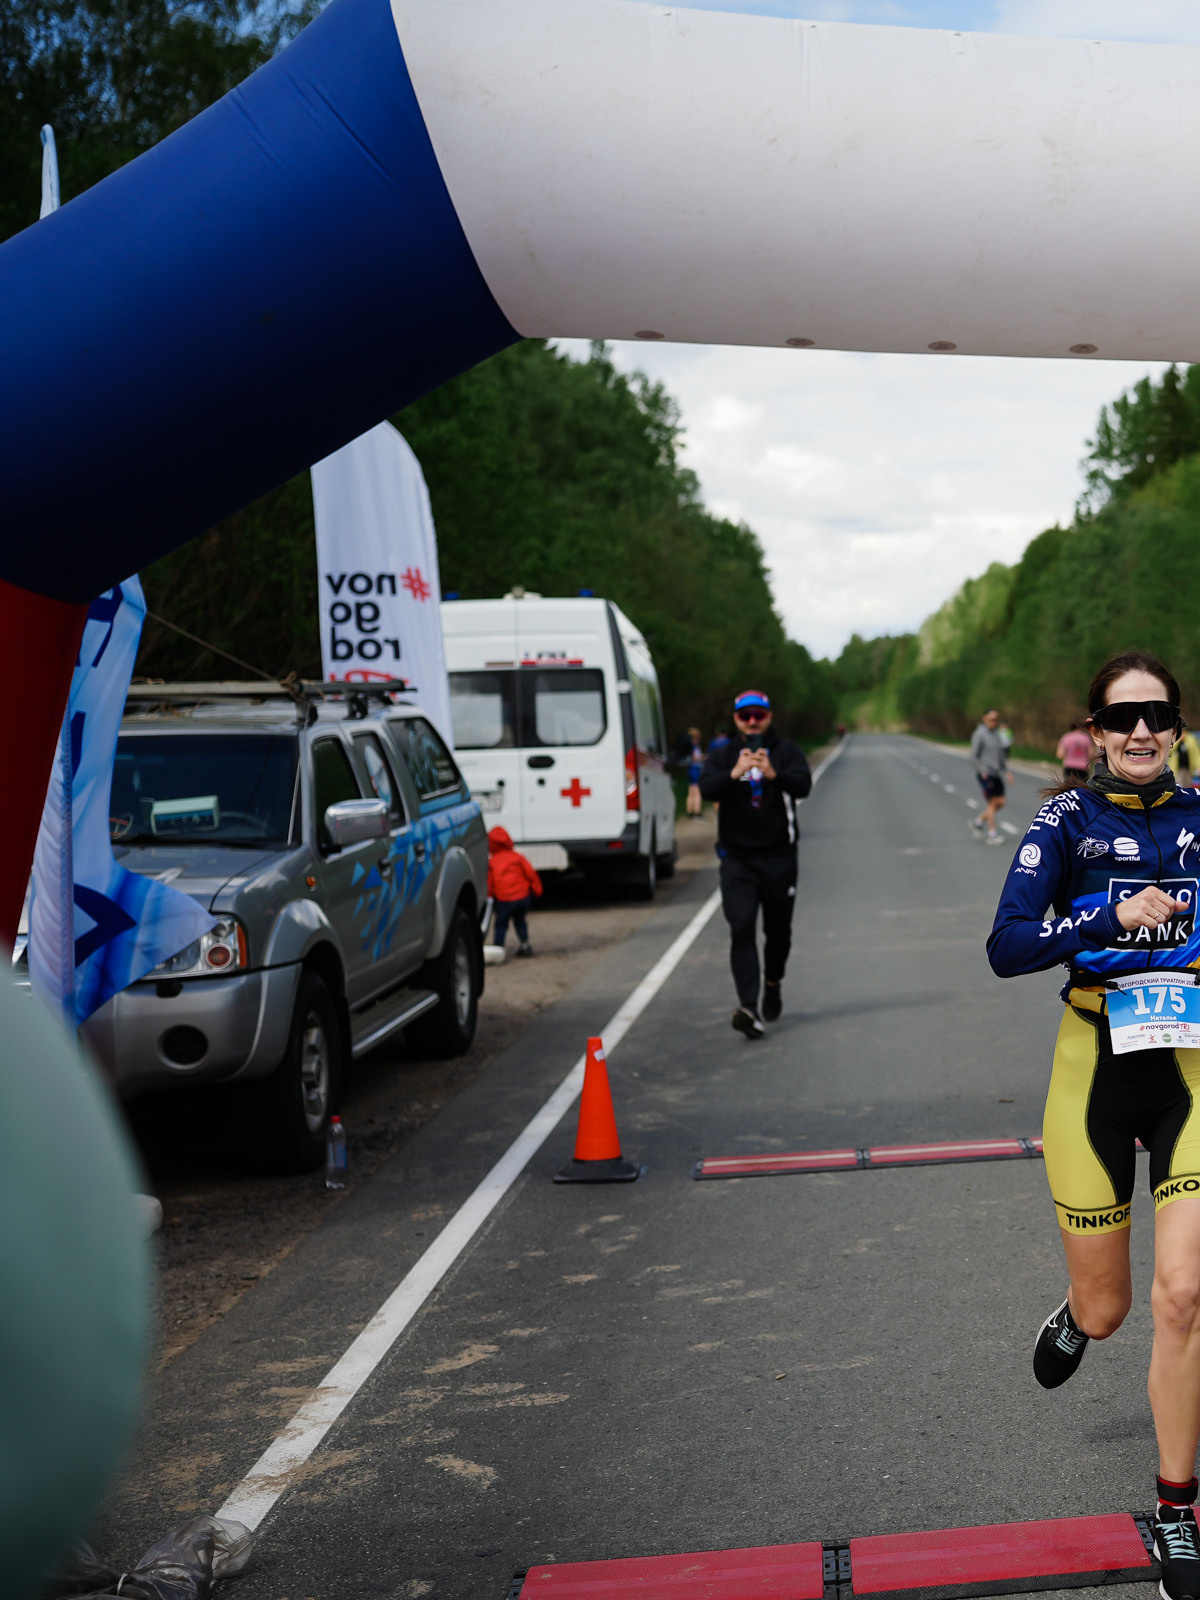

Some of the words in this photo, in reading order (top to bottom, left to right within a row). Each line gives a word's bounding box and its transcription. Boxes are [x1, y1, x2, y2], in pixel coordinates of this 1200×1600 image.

[1119, 888, 1192, 906] SO
[1118, 977, 1160, 989] ОВГОРОДСКИЙ
[1132, 986, 1187, 1016] 175
[1065, 1206, 1131, 1229] TINKOF
